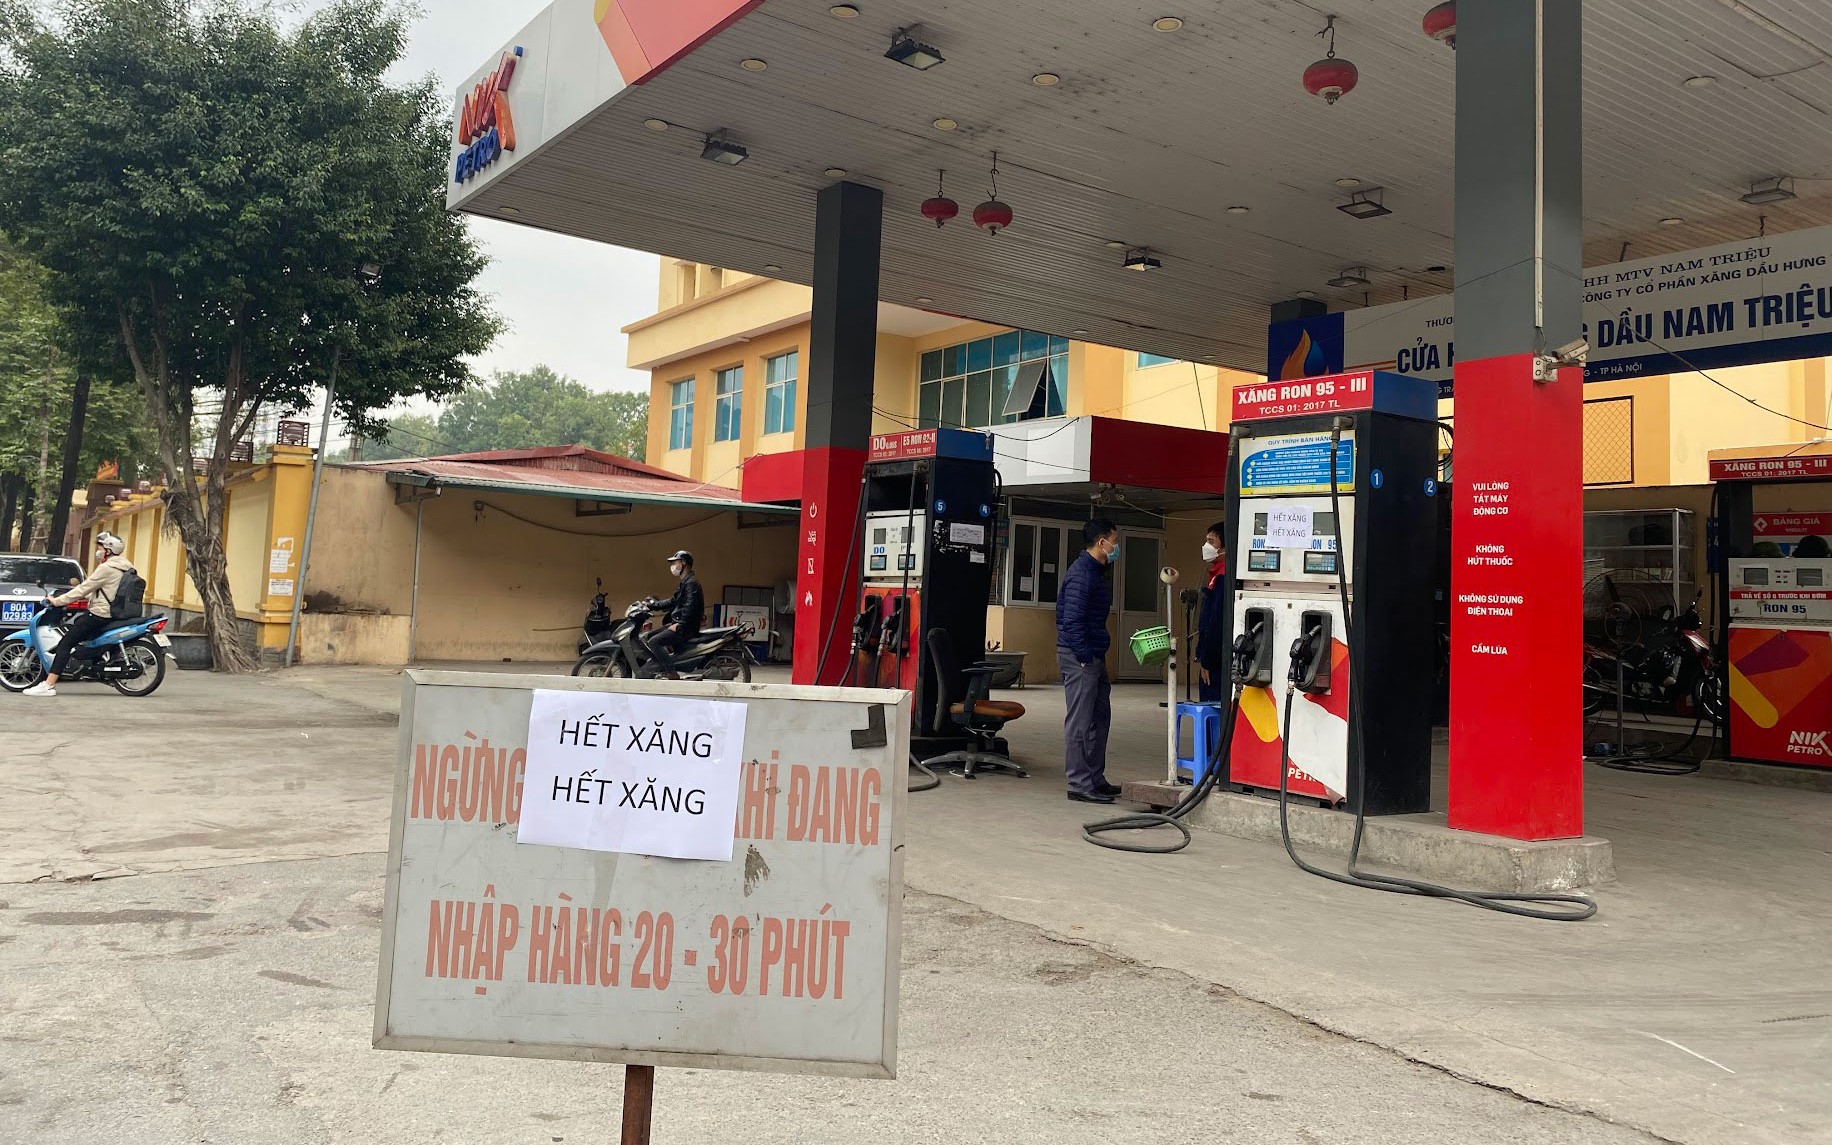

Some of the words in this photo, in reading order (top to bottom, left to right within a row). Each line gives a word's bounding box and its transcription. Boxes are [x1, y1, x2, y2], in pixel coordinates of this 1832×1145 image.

[455, 129, 501, 184] PETRO
[1615, 267, 1654, 283] MTV
[1660, 258, 1703, 275] NAM
[1709, 246, 1772, 267] TRIỆU
[1583, 290, 1612, 303] ÔNG
[1616, 287, 1632, 298] TY
[1700, 269, 1741, 284] XĂNG
[1747, 261, 1779, 277] DẦU
[1783, 256, 1826, 271] HƯNG
[1598, 307, 1652, 348] DẦU
[1663, 301, 1734, 340] NAM
[1744, 283, 1832, 329] TRIỆU
[1397, 337, 1440, 373] CỬA
[1600, 367, 1609, 375] TP
[1611, 363, 1624, 374] HÀ
[1626, 361, 1643, 374] NỘI
[1238, 387, 1277, 405] XĂNG
[1281, 382, 1312, 400] RON
[1316, 381, 1335, 397] 95
[1350, 377, 1367, 393] III
[1259, 405, 1284, 415] TCCS
[1287, 403, 1300, 413] 01:
[1303, 401, 1325, 411] 2017
[1328, 400, 1340, 408] TL
[903, 436, 910, 446] E5
[1724, 462, 1756, 472] XĂNG
[1759, 461, 1784, 470] RON
[1787, 460, 1802, 469] 95
[1814, 459, 1827, 468] III
[1374, 473, 1379, 486] 1
[1472, 482, 1486, 491] VUI
[1487, 480, 1510, 491] LÒNG
[1427, 480, 1433, 493] 2
[1473, 492, 1489, 503] TẮT
[1490, 493, 1509, 503] MÁY
[937, 501, 943, 511] 5
[1473, 505, 1496, 517] ĐỘNG
[1497, 506, 1509, 515] CƠ
[1273, 511, 1286, 522] HẾT
[1287, 513, 1307, 523] XĂNG
[1803, 516, 1821, 525] GIÁ
[1272, 526, 1285, 537] HẾT
[1286, 528, 1306, 538] XĂNG
[1252, 538, 1266, 549] RON
[1310, 539, 1322, 550] ON
[1328, 539, 1337, 550] 95
[1475, 543, 1505, 553] KHÔNG
[874, 546, 885, 554] DO
[1467, 555, 1484, 566] HÚT
[1485, 554, 1514, 566] THUỐC
[1458, 593, 1487, 603] KHÔNG
[1500, 595, 1524, 605] DỤNG
[10, 603, 26, 612] 80A
[1467, 605, 1487, 616] ĐIỆN
[1764, 603, 1788, 613] RON
[1792, 604, 1807, 613] 95
[4, 611, 33, 620] 029.83
[1471, 642, 1490, 654] CẤM
[559, 713, 619, 750] HẾT
[626, 723, 714, 759] XĂNG
[1789, 730, 1832, 756] NIK
[1786, 744, 1823, 756] PETRO
[411, 730, 527, 825] NGỪNG
[786, 764, 881, 847] ĐANG
[552, 769, 613, 806] HẾT
[619, 777, 707, 816] XĂNG
[424, 884, 519, 996] NHẬP
[527, 892, 622, 987] HÀNG
[630, 911, 675, 991] 20
[707, 915, 750, 996] 30
[759, 903, 851, 1000] PHÚT
